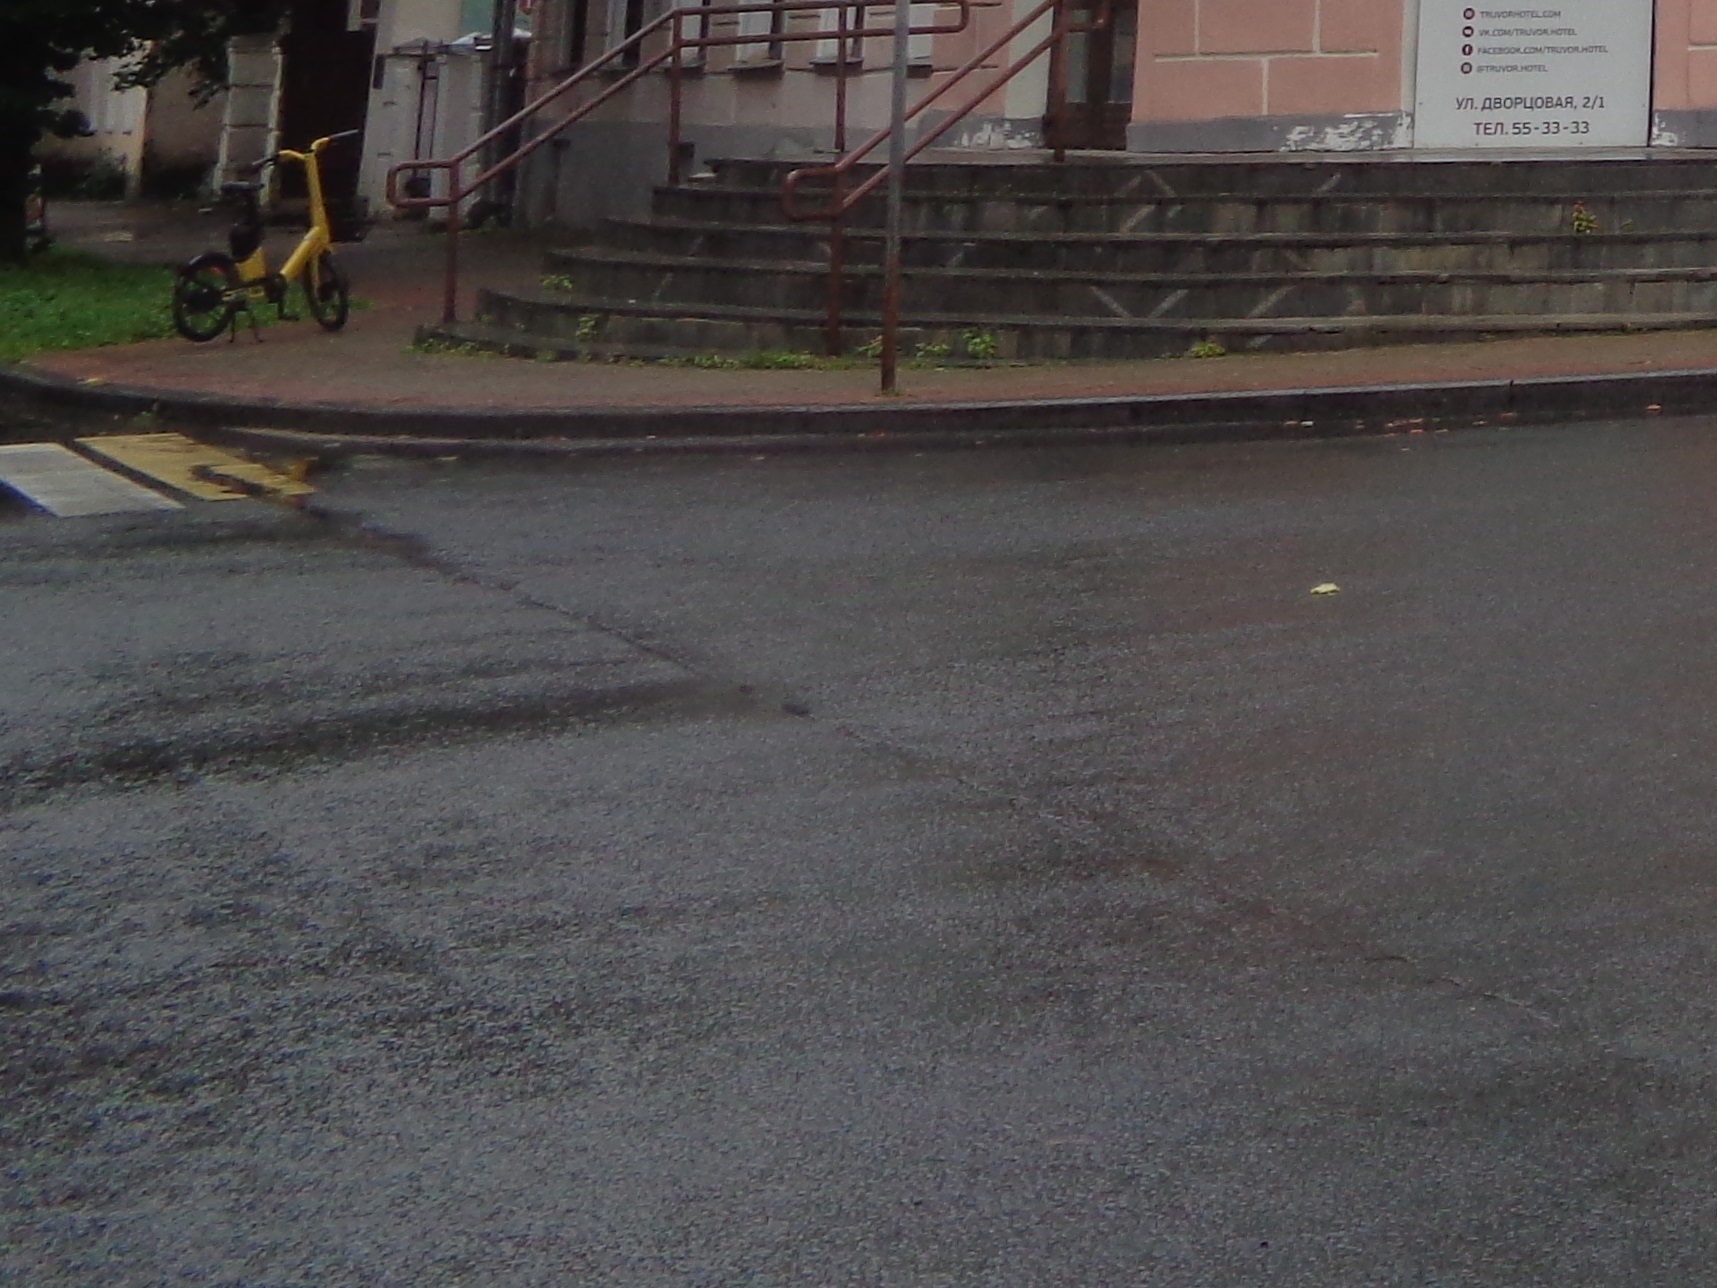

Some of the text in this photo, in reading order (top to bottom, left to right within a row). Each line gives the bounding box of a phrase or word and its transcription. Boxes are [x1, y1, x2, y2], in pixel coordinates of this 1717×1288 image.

[1456, 95, 1606, 112] УЛ. ДВОРЦОВАЯ, 2/1
[1474, 120, 1590, 136] ТЕЛ. 55-33-33
